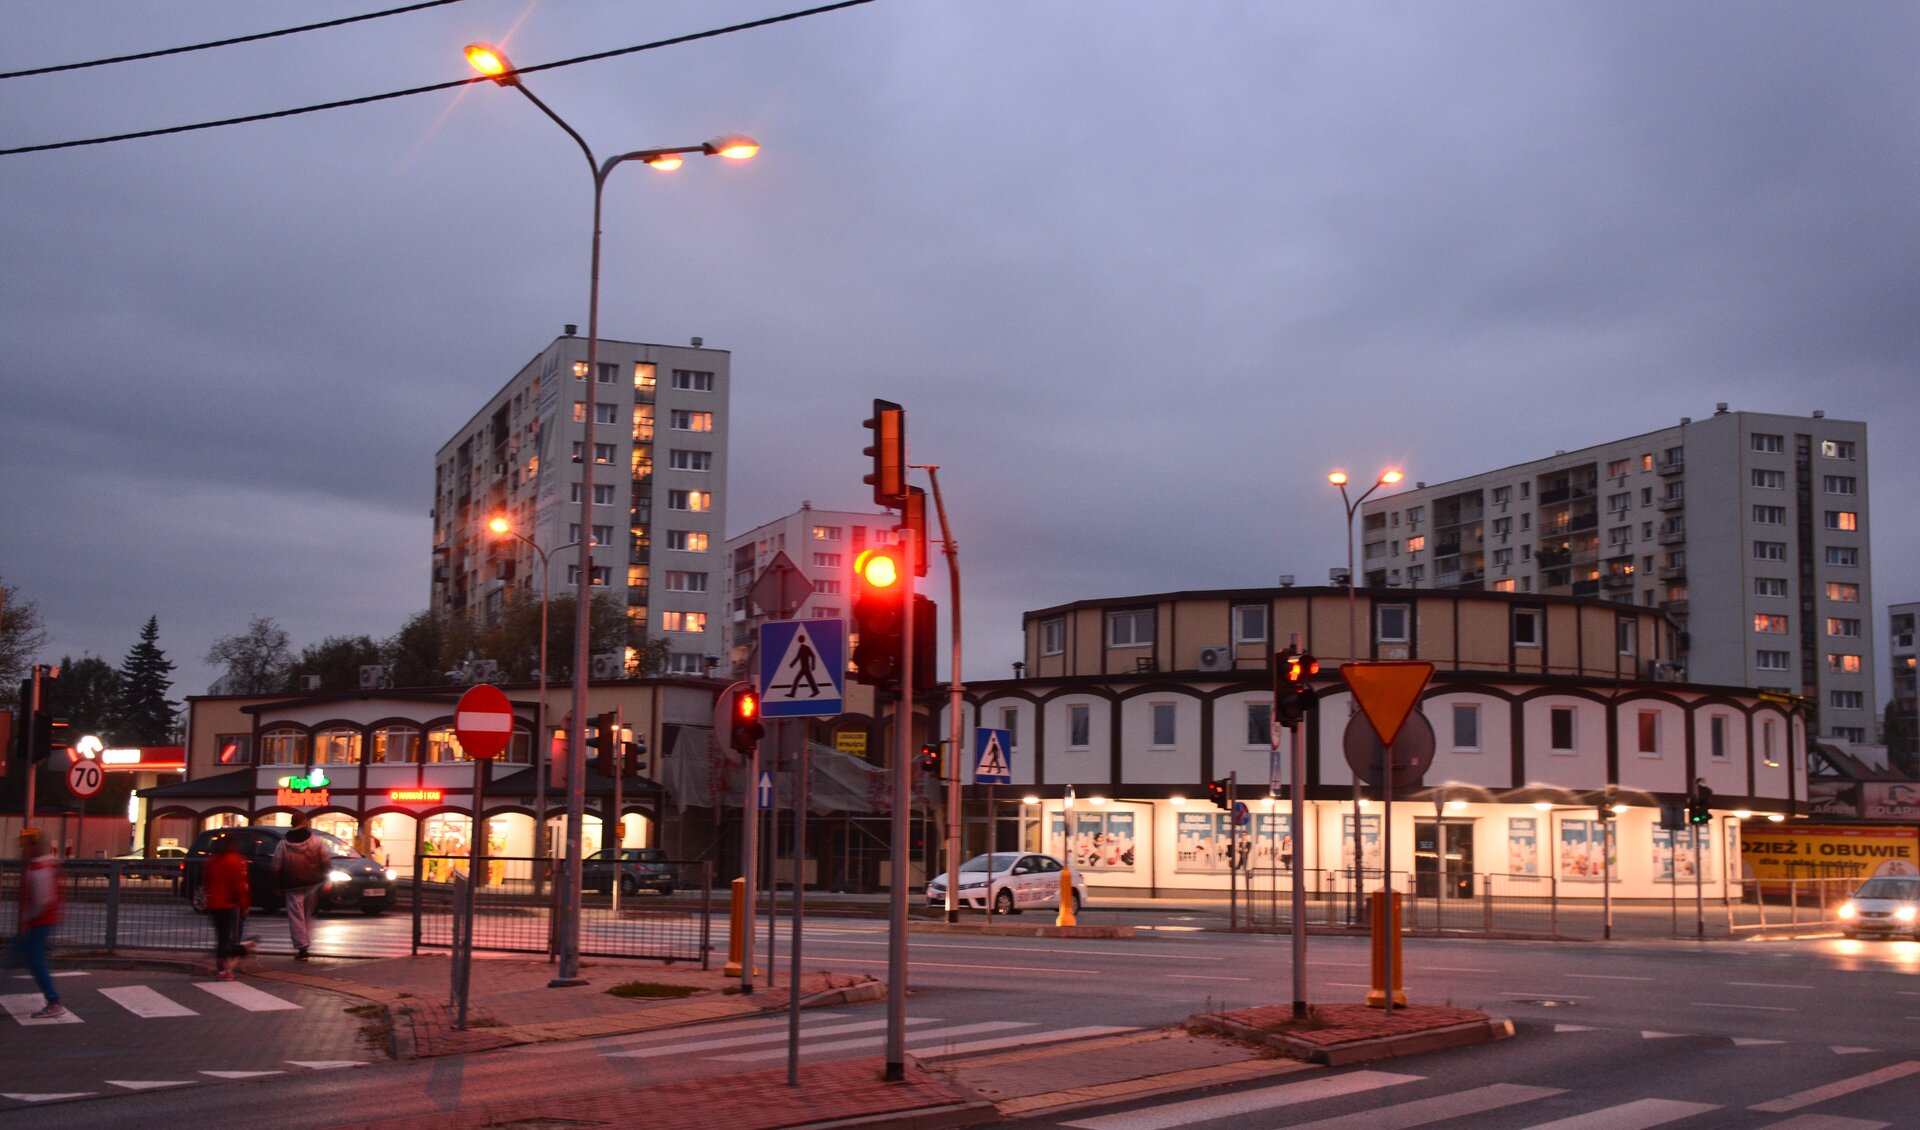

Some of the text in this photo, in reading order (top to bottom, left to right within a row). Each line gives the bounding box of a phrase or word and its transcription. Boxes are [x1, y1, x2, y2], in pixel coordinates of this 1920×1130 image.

[74, 767, 99, 788] 70
[277, 788, 330, 806] Market
[1805, 842, 1812, 855] i
[1819, 843, 1911, 858] OBUWIE
[1759, 858, 1780, 866] dla
